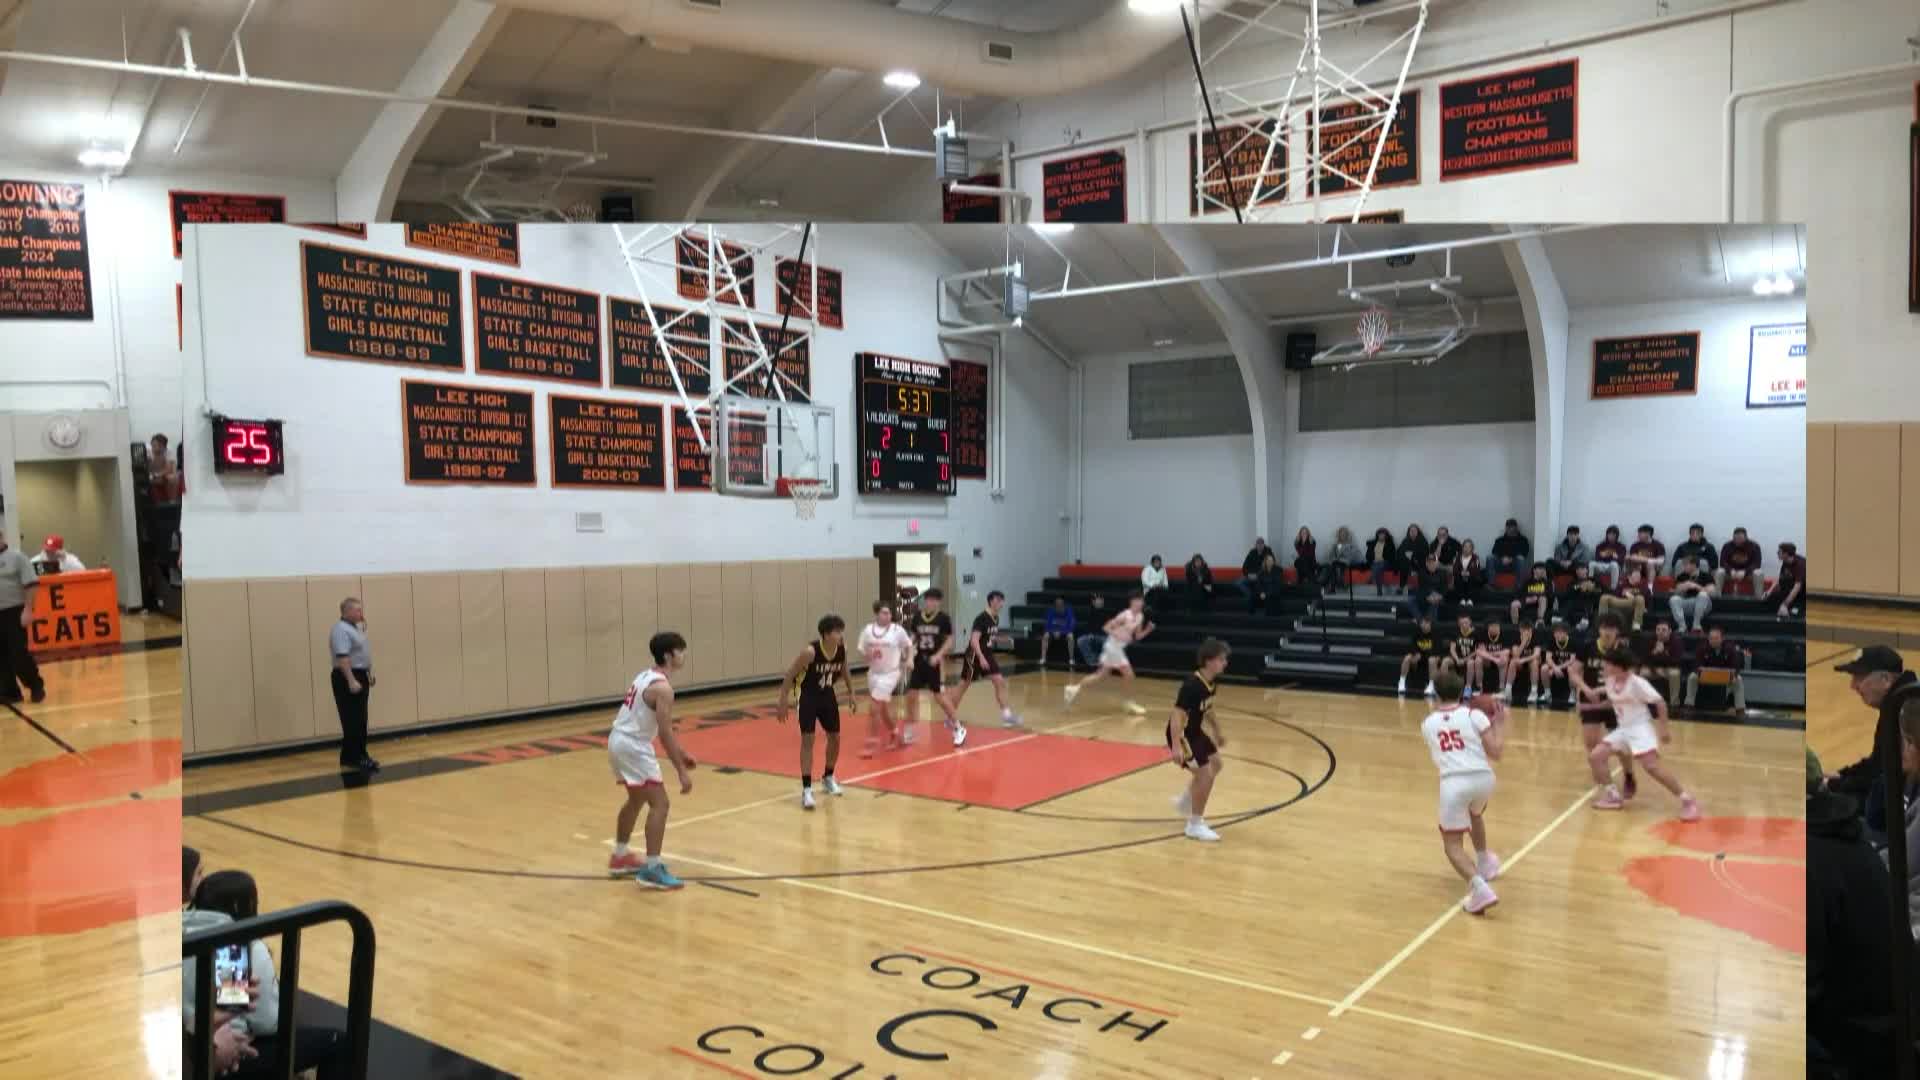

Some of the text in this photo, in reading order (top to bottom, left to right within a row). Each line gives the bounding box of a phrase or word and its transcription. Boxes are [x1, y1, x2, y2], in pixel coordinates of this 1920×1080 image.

[1467, 110, 1547, 135] FOOTBALL
[1465, 128, 1548, 151] CHAMPIONS
[0, 183, 77, 206] OWLING
[21, 236, 81, 252] Champions
[428, 223, 499, 247] CHAMPIONS
[21, 250, 54, 263] 2024
[24, 267, 83, 280] Individuals
[342, 256, 428, 284] LEE HIGH
[317, 271, 451, 308] MASSACHUSETTS DIVISION III
[500, 283, 577, 308] LEE HIGH
[322, 293, 449, 327] STATE CHAMPIONS
[480, 295, 546, 320] MASSACHUSETTS
[587, 313, 596, 328] III
[328, 315, 447, 345] GIRLS BASKETBALL
[484, 316, 594, 345] STATE CHAMPIONS
[487, 334, 591, 363] GIRLS BASKETBALL
[618, 335, 649, 353] STATE
[621, 352, 647, 369] GIRLS
[874, 356, 942, 378] LEE HIGH SCHOOL
[436, 389, 507, 408] LEE HIGH
[898, 387, 930, 413] 5:37
[414, 404, 476, 423] MASSACHUSETTS
[515, 413, 526, 428] III
[580, 403, 638, 420] LEE HIGH
[866, 411, 899, 425] WILDCATS
[420, 425, 522, 445] STATE CHAMPIONS
[560, 416, 613, 434] MASSACHUSETTS
[646, 424, 656, 437] III
[927, 418, 947, 430] GUEST
[227, 427, 271, 465] 25
[566, 433, 653, 453] STATE CHAMPIONS
[882, 426, 891, 449] 2
[940, 432, 948, 453] 7
[424, 444, 520, 464] GIRLS BASKETBALL
[568, 451, 651, 468] GIRLS BASKETBALL
[872, 458, 880, 478] 0
[941, 463, 949, 481] 0
[1438, 730, 1465, 752] 25
[870, 954, 1169, 1042] COACH
[876, 1009, 998, 1061] C
